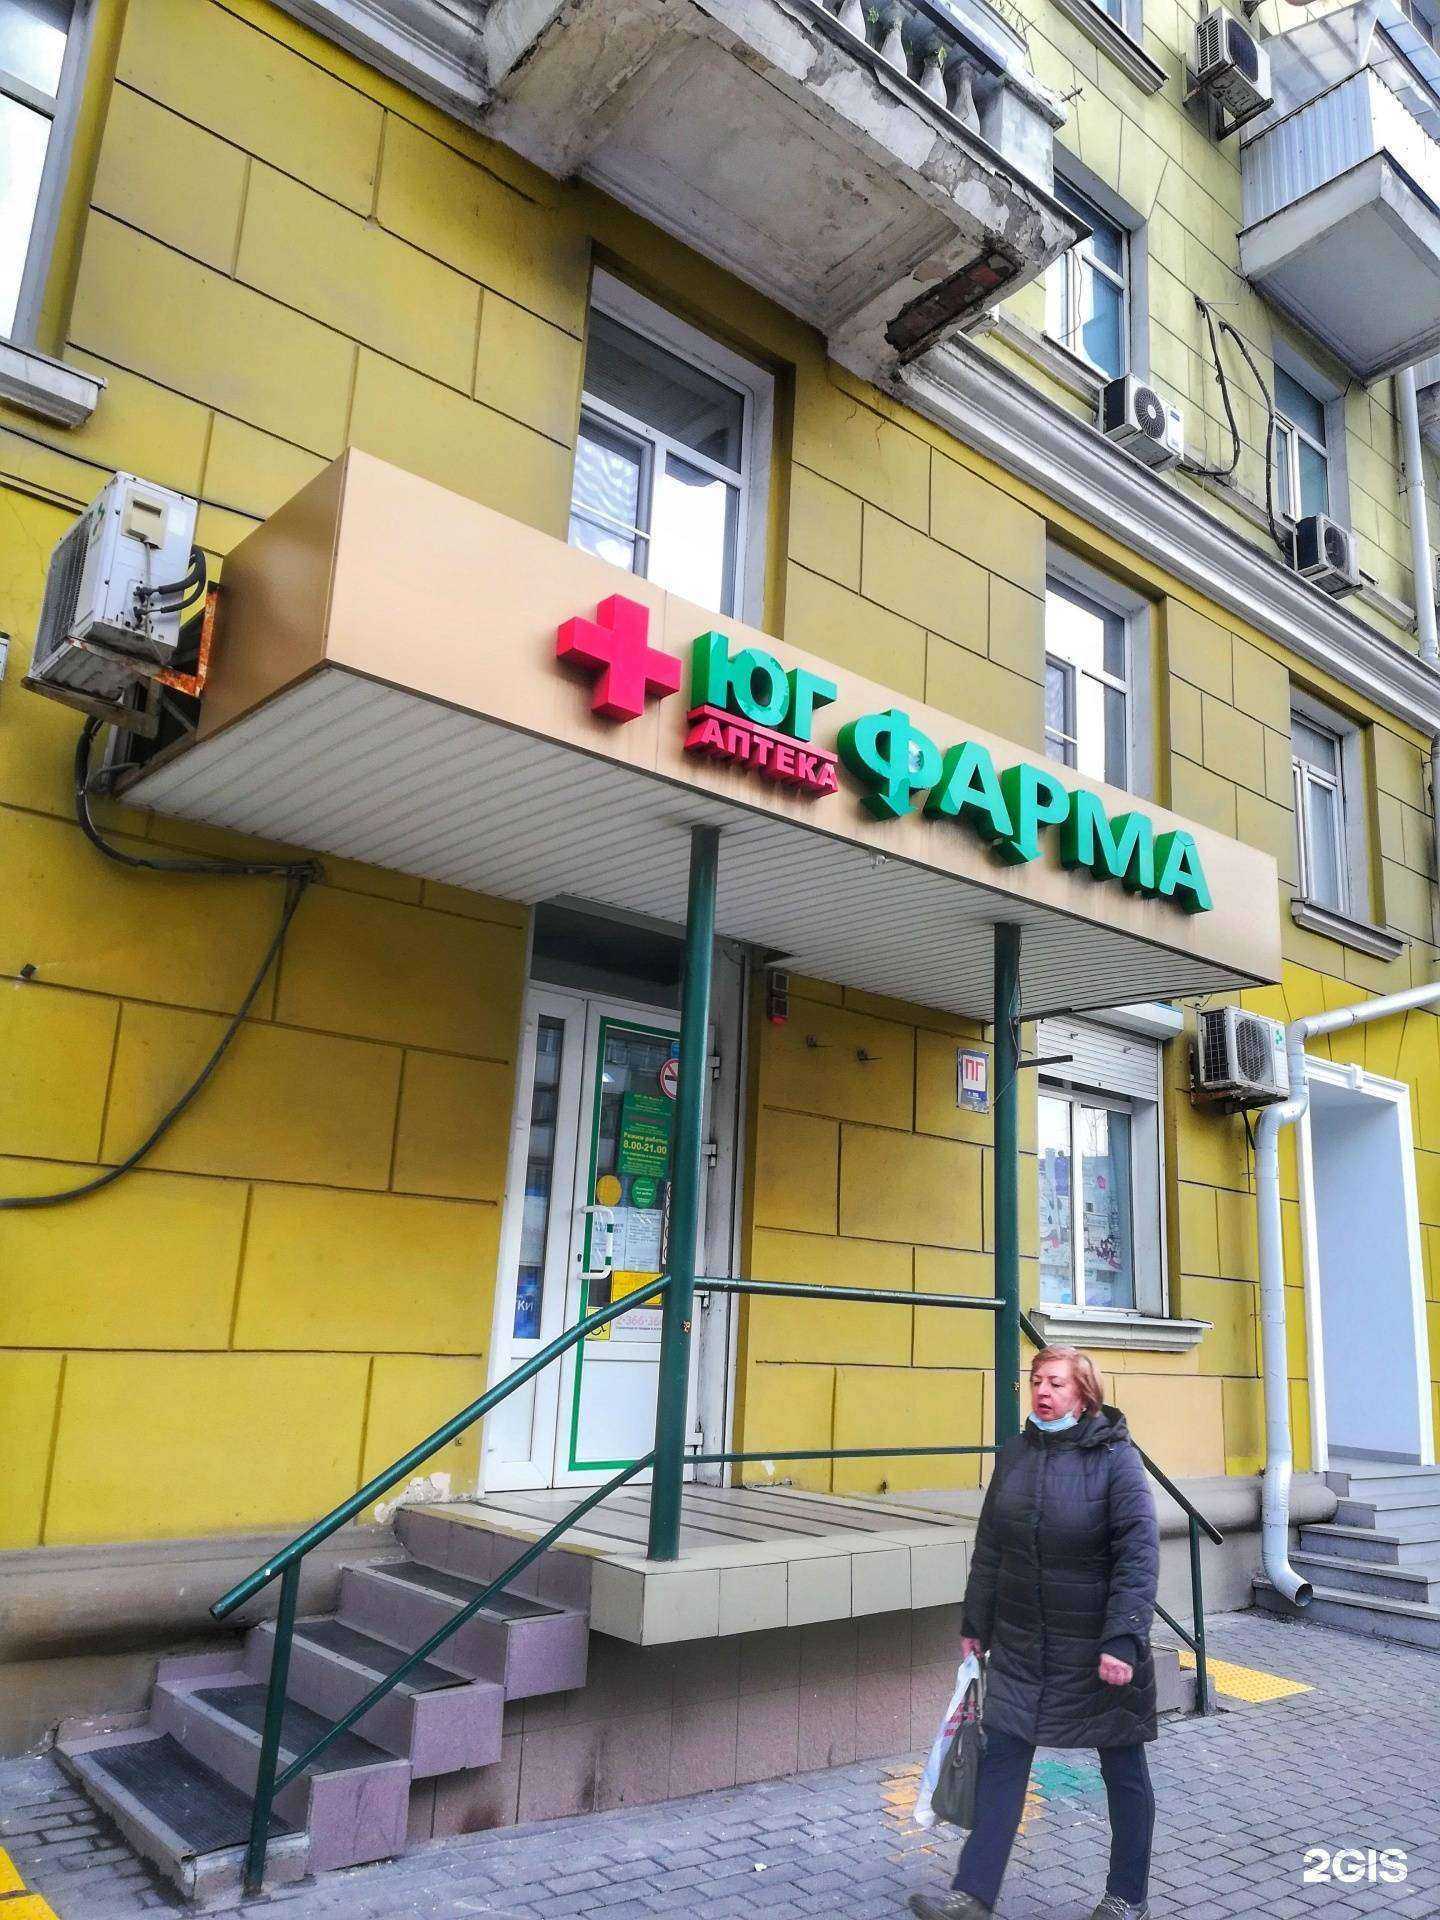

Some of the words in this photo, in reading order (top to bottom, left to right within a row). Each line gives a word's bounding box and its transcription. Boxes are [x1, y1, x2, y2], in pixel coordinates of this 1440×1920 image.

[688, 718, 838, 796] АПТЕКА
[691, 631, 838, 742] ЮГ
[838, 709, 1213, 914] ФАРМА
[965, 1058, 985, 1081] ПГ
[623, 1139, 667, 1154] 8.00-21.00
